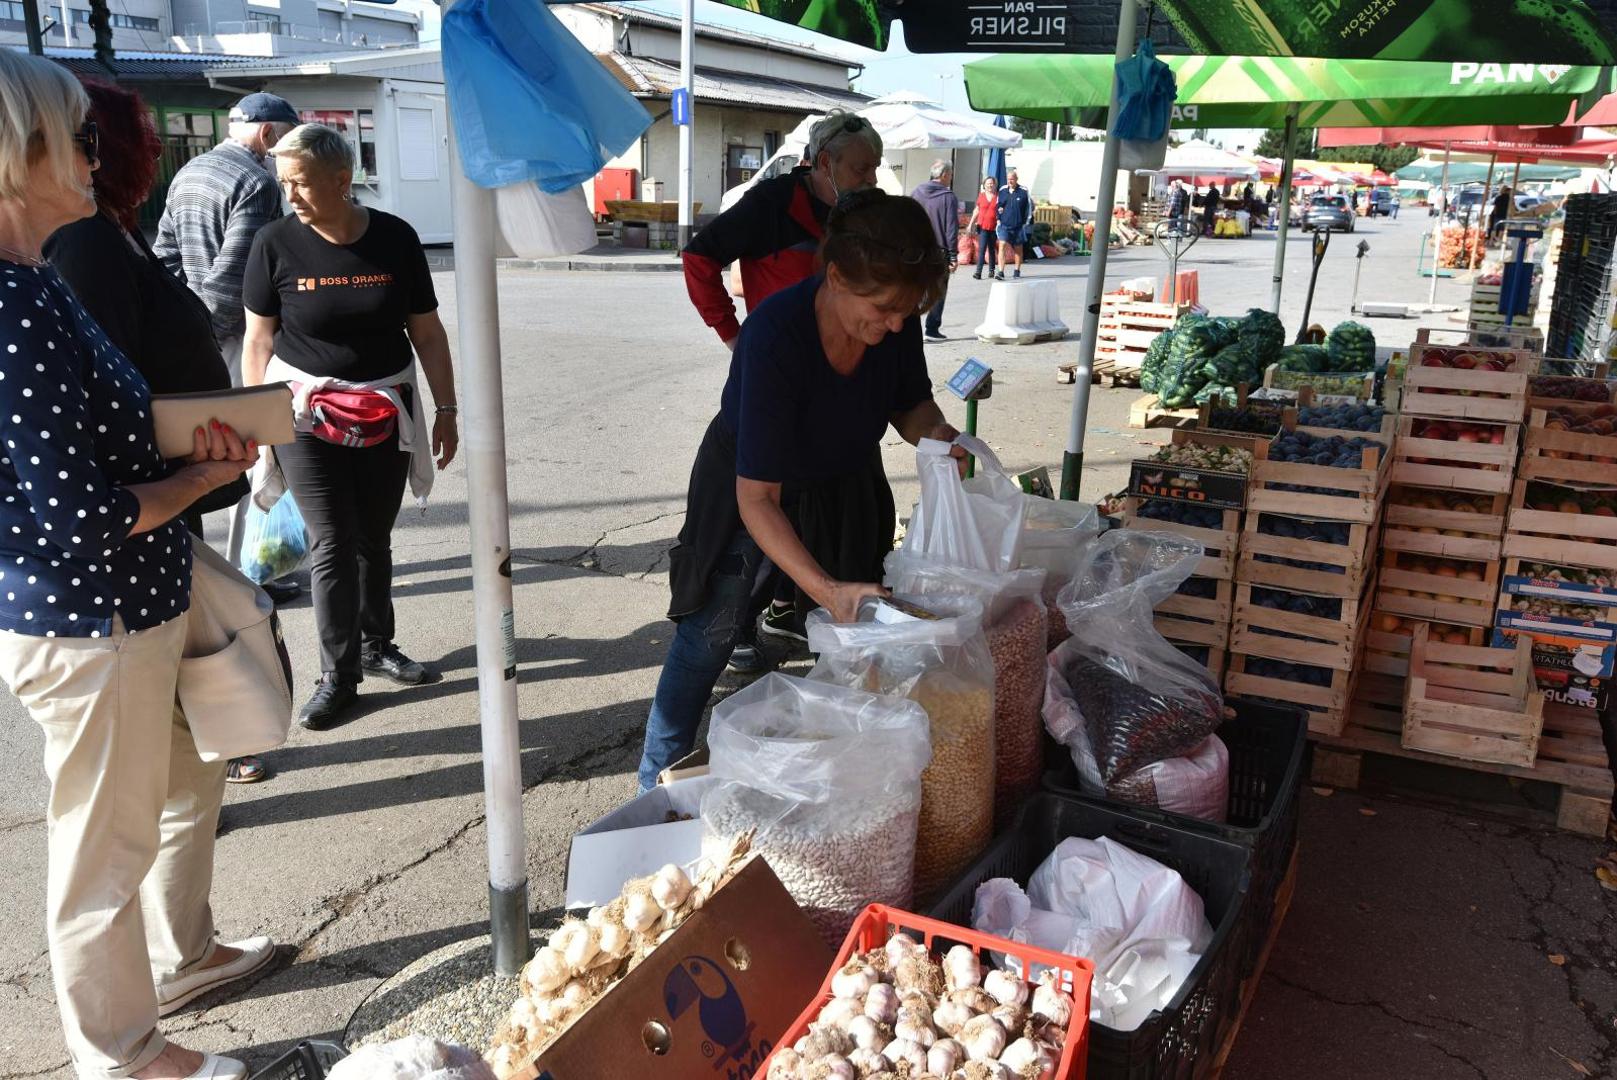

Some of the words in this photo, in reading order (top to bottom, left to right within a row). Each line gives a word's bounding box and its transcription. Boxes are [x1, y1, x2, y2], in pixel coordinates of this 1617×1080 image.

[1449, 61, 1535, 85] PAN
[320, 276, 349, 286] BOSS
[1140, 484, 1206, 502] NICO
[1541, 688, 1598, 709] gusta
